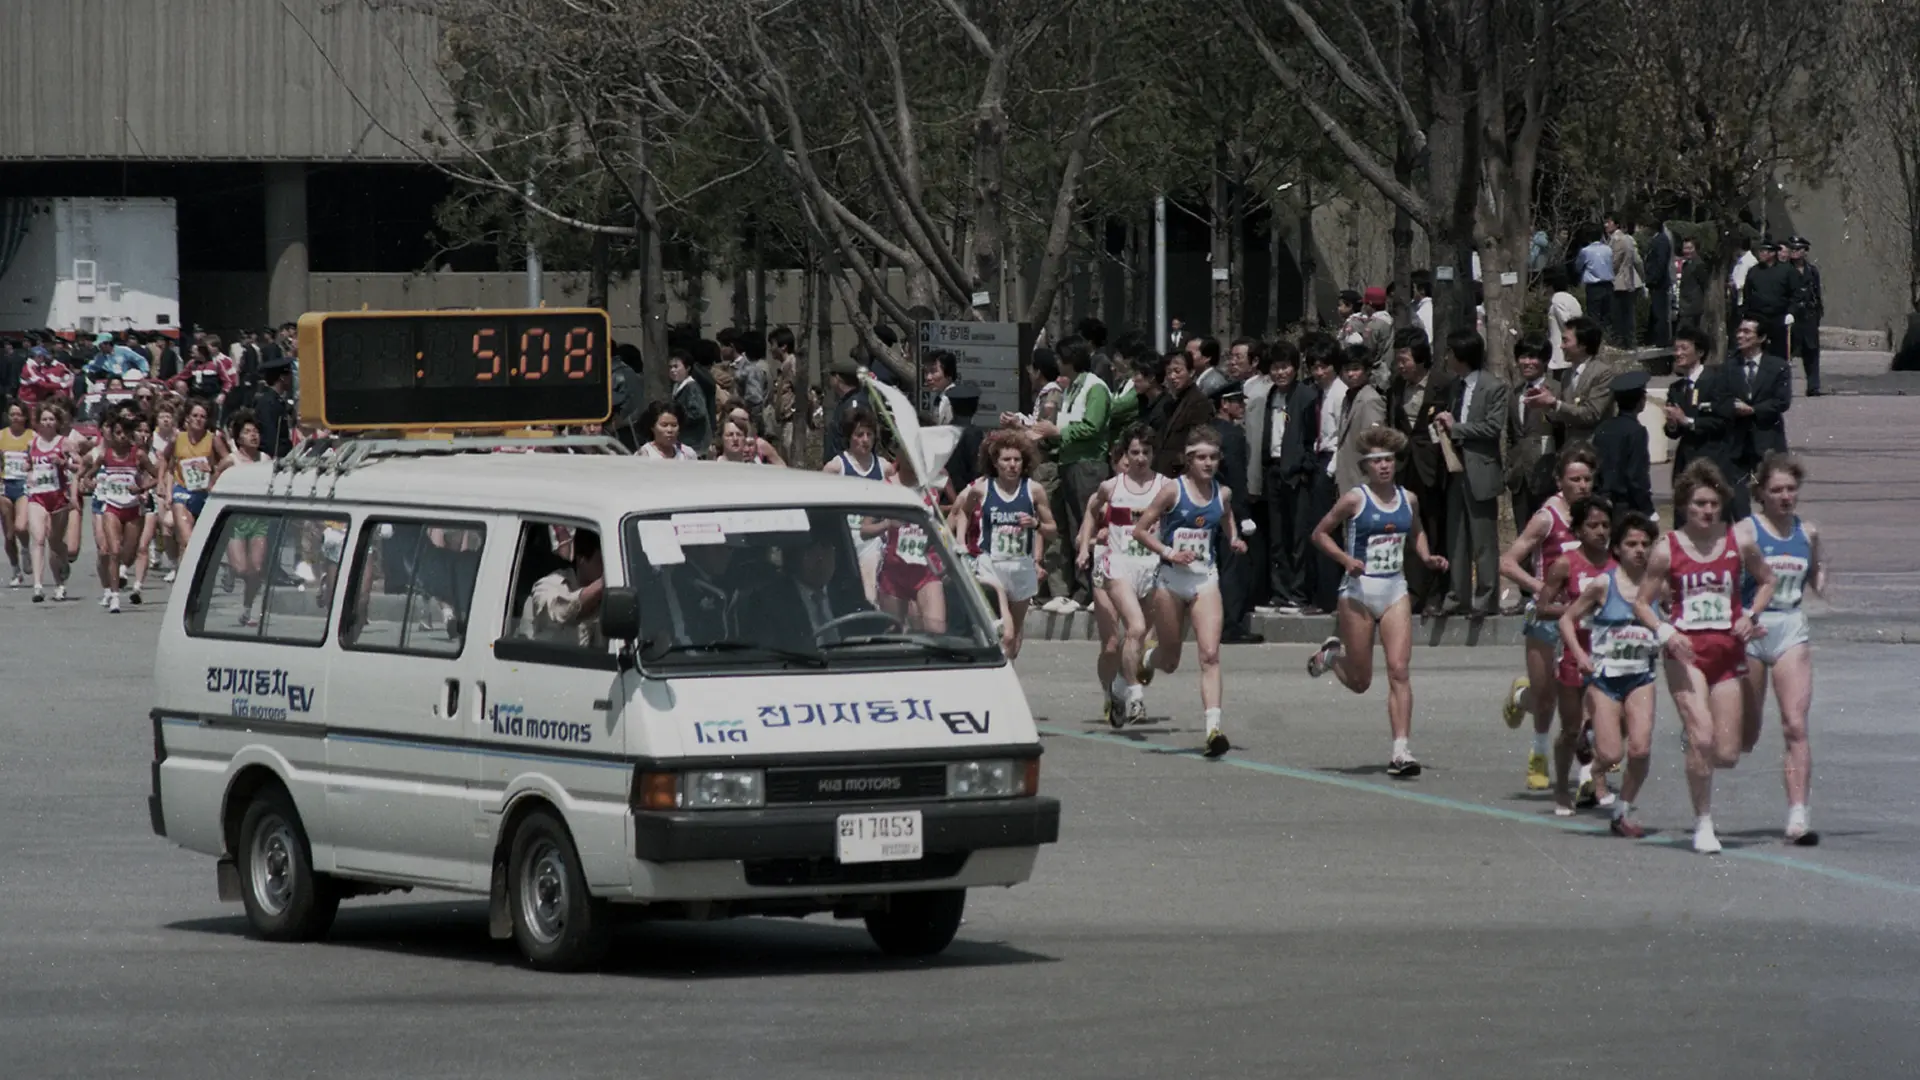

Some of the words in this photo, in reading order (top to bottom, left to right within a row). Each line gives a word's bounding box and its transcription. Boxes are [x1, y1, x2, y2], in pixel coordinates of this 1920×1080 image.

[990, 510, 1024, 524] FRANC
[1681, 571, 1733, 595] USA
[206, 666, 288, 696] 전기자동차
[287, 685, 315, 713] EV
[757, 698, 935, 728] 전기자동차
[938, 710, 991, 735] EV
